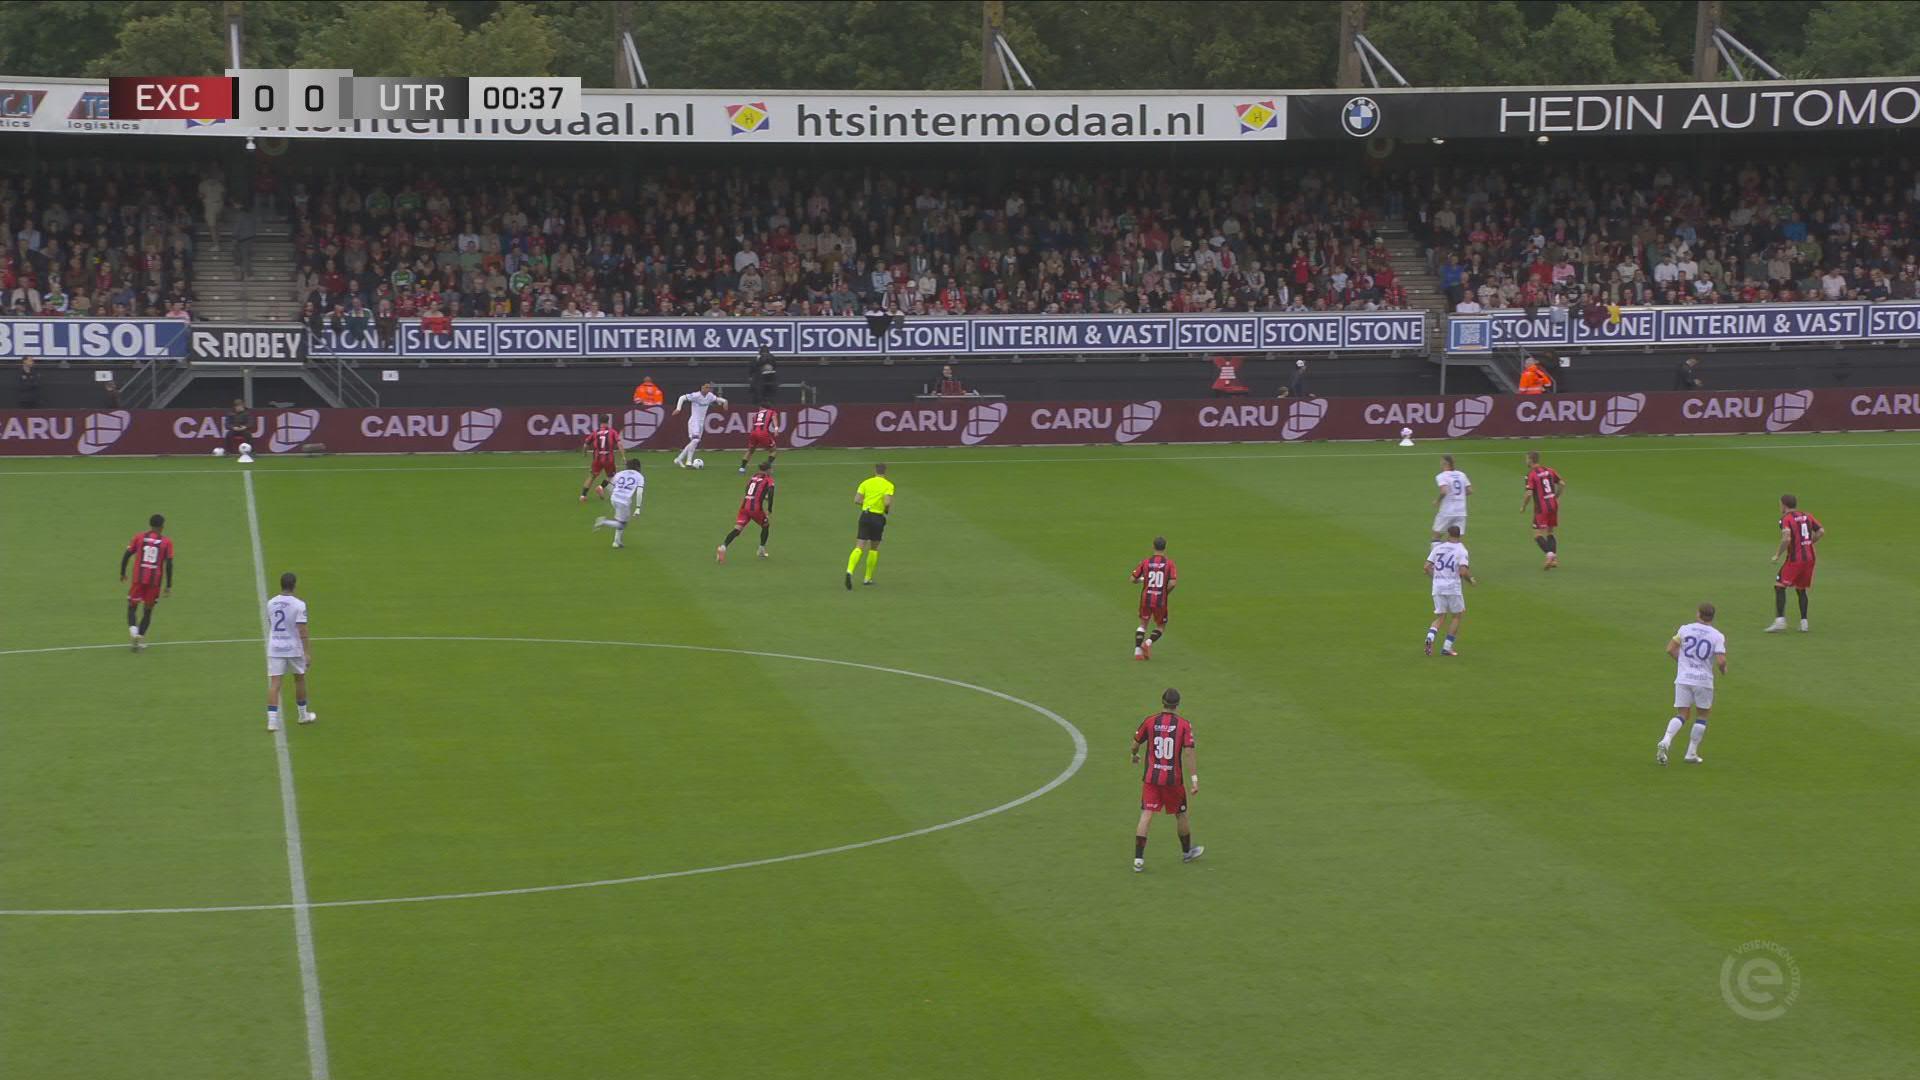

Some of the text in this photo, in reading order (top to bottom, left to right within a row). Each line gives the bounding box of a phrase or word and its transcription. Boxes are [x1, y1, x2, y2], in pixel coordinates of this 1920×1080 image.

[797, 103, 1205, 137] htsintermodaal.nl
[1500, 87, 1920, 132] HEDIN AUTOMO
[68, 120, 139, 131] logistics
[1350, 321, 1421, 342] STONE
[1669, 312, 1857, 335] INTERIM & VAST
[1873, 311, 1920, 331] STO
[500, 329, 577, 349] STONE
[594, 328, 788, 349] INTERIM & VAST
[802, 328, 877, 348] STONE
[893, 326, 964, 347] STONE
[980, 324, 1167, 346] INTERIM & VAST
[1180, 324, 1252, 344] STONE
[1265, 322, 1337, 343] STONE
[223, 332, 301, 358] ROBEY
[1199, 405, 1279, 427] CARU
[1364, 403, 1444, 425] CARU
[1516, 400, 1596, 422] CARU
[1682, 397, 1763, 419] CARU
[0, 417, 73, 440] ARU
[173, 416, 265, 439] CAU
[361, 415, 448, 437] CARU
[875, 410, 957, 432] CARU
[1031, 408, 1112, 430] CARU
[599, 435, 606, 449] 7
[617, 476, 636, 490] 92
[748, 482, 756, 495] 8
[1453, 480, 1461, 495] 9
[1542, 479, 1551, 493] 3
[1800, 523, 1809, 539] 4
[143, 545, 158, 563] 19
[1435, 553, 1455, 572] 34
[1148, 570, 1164, 587] 20
[274, 610, 286, 632] 2
[1684, 636, 1711, 661] 20
[1153, 736, 1174, 760] 30
